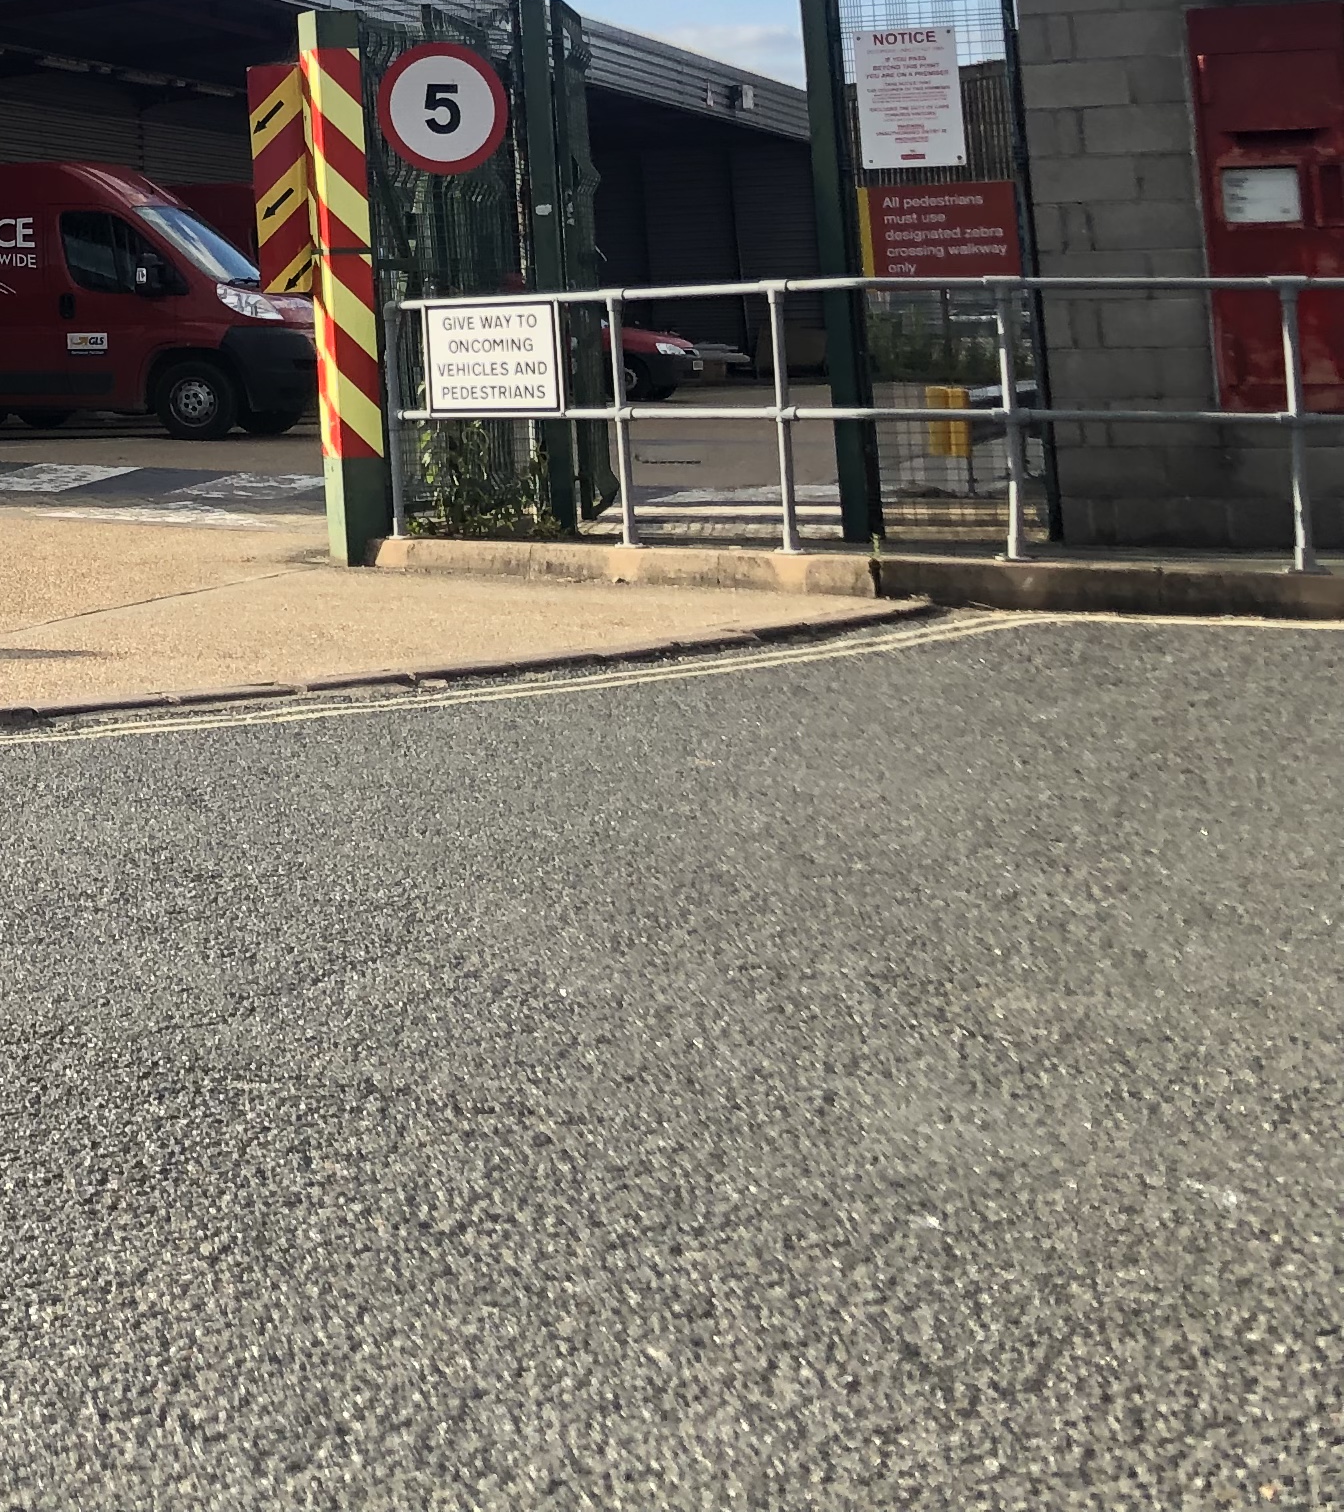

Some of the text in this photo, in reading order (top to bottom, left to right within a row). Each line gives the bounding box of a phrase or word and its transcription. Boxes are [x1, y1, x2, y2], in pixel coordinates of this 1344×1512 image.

[873, 31, 936, 46] NOTICE
[424, 84, 461, 135] 5
[883, 194, 983, 210] All pedestrians
[884, 212, 946, 225] must use
[885, 226, 1003, 242] designated zebra
[887, 243, 1007, 258] crossing walkway
[888, 262, 916, 275] only
[443, 314, 537, 331] GIVE WAY TO
[89, 337, 104, 345] GLS
[449, 338, 534, 354] ONCOMING
[437, 361, 547, 377] VEHICLES AND
[442, 385, 546, 400] PEDESTRIANS
